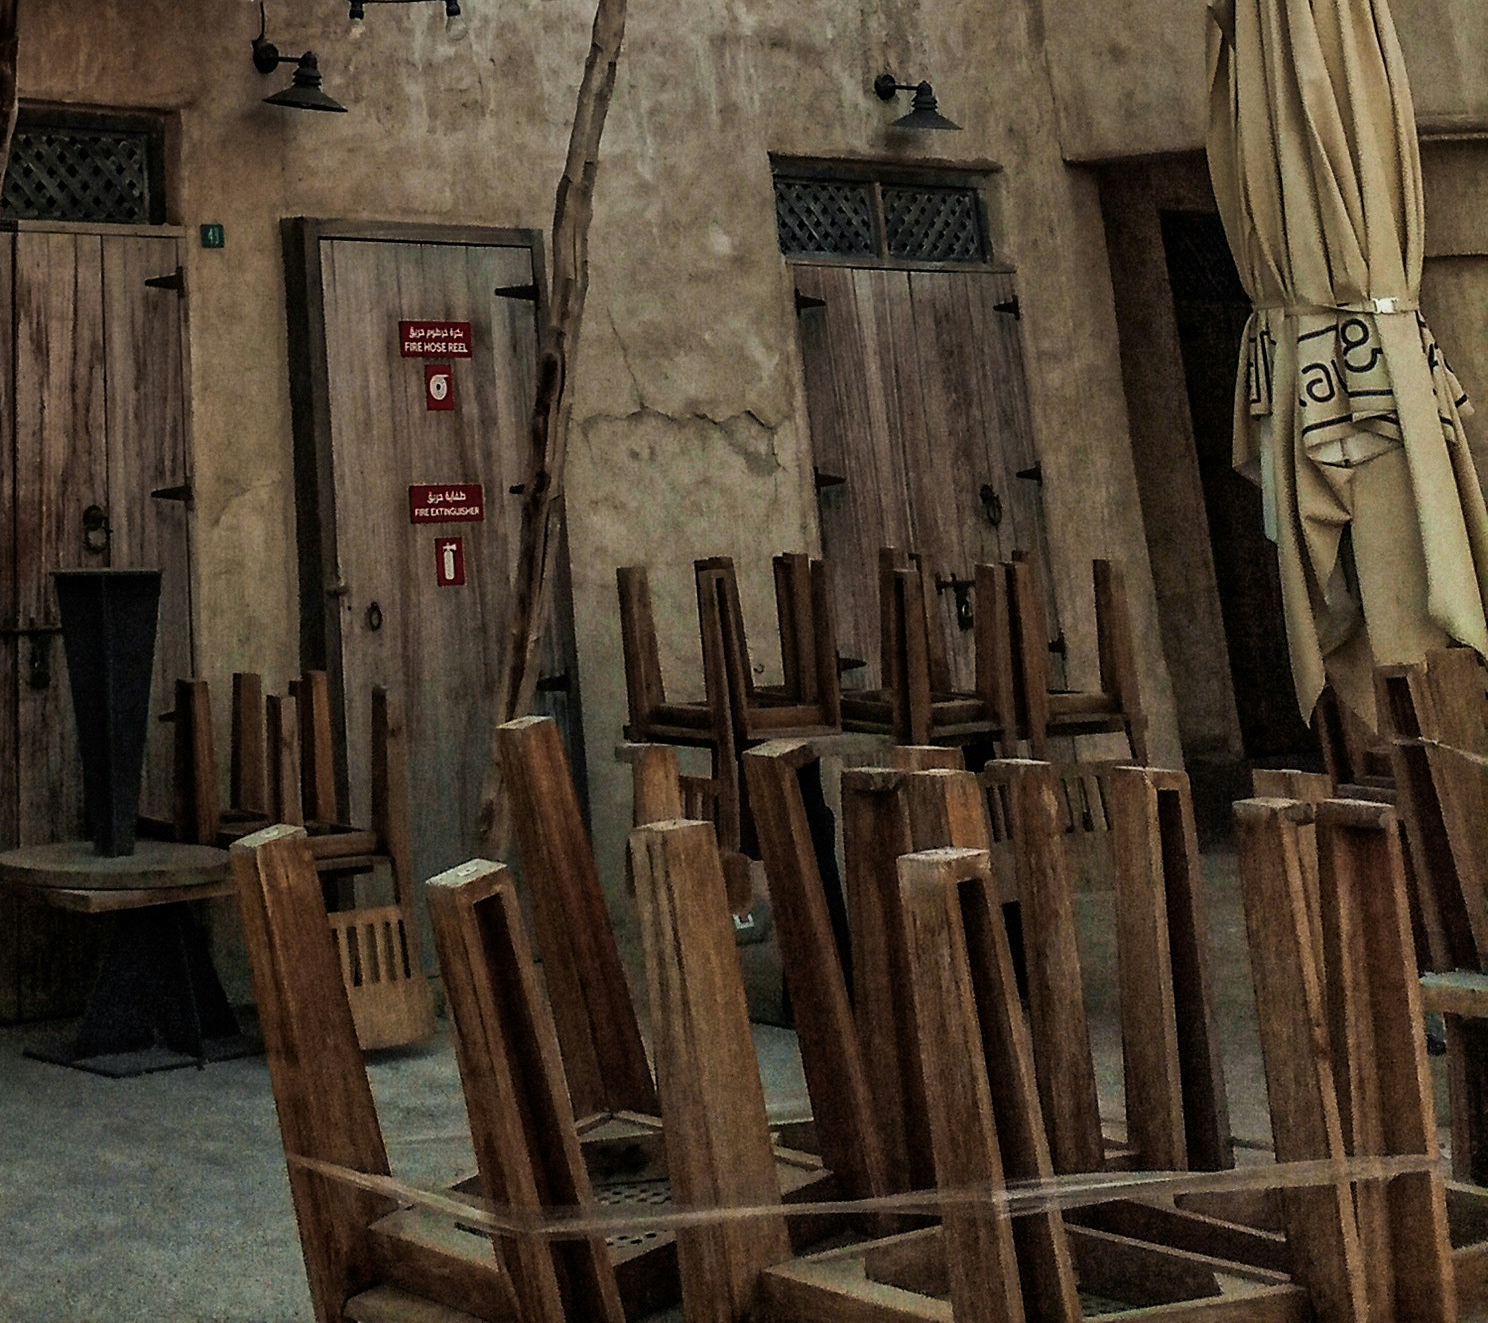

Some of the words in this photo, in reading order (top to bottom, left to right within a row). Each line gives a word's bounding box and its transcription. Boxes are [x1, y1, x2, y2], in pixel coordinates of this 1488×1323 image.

[404, 341, 423, 353] FIRE
[424, 342, 447, 353] HOSE
[448, 342, 469, 353] REEL
[414, 508, 430, 517] FIRE
[430, 506, 480, 517] EXTINGUISHER
